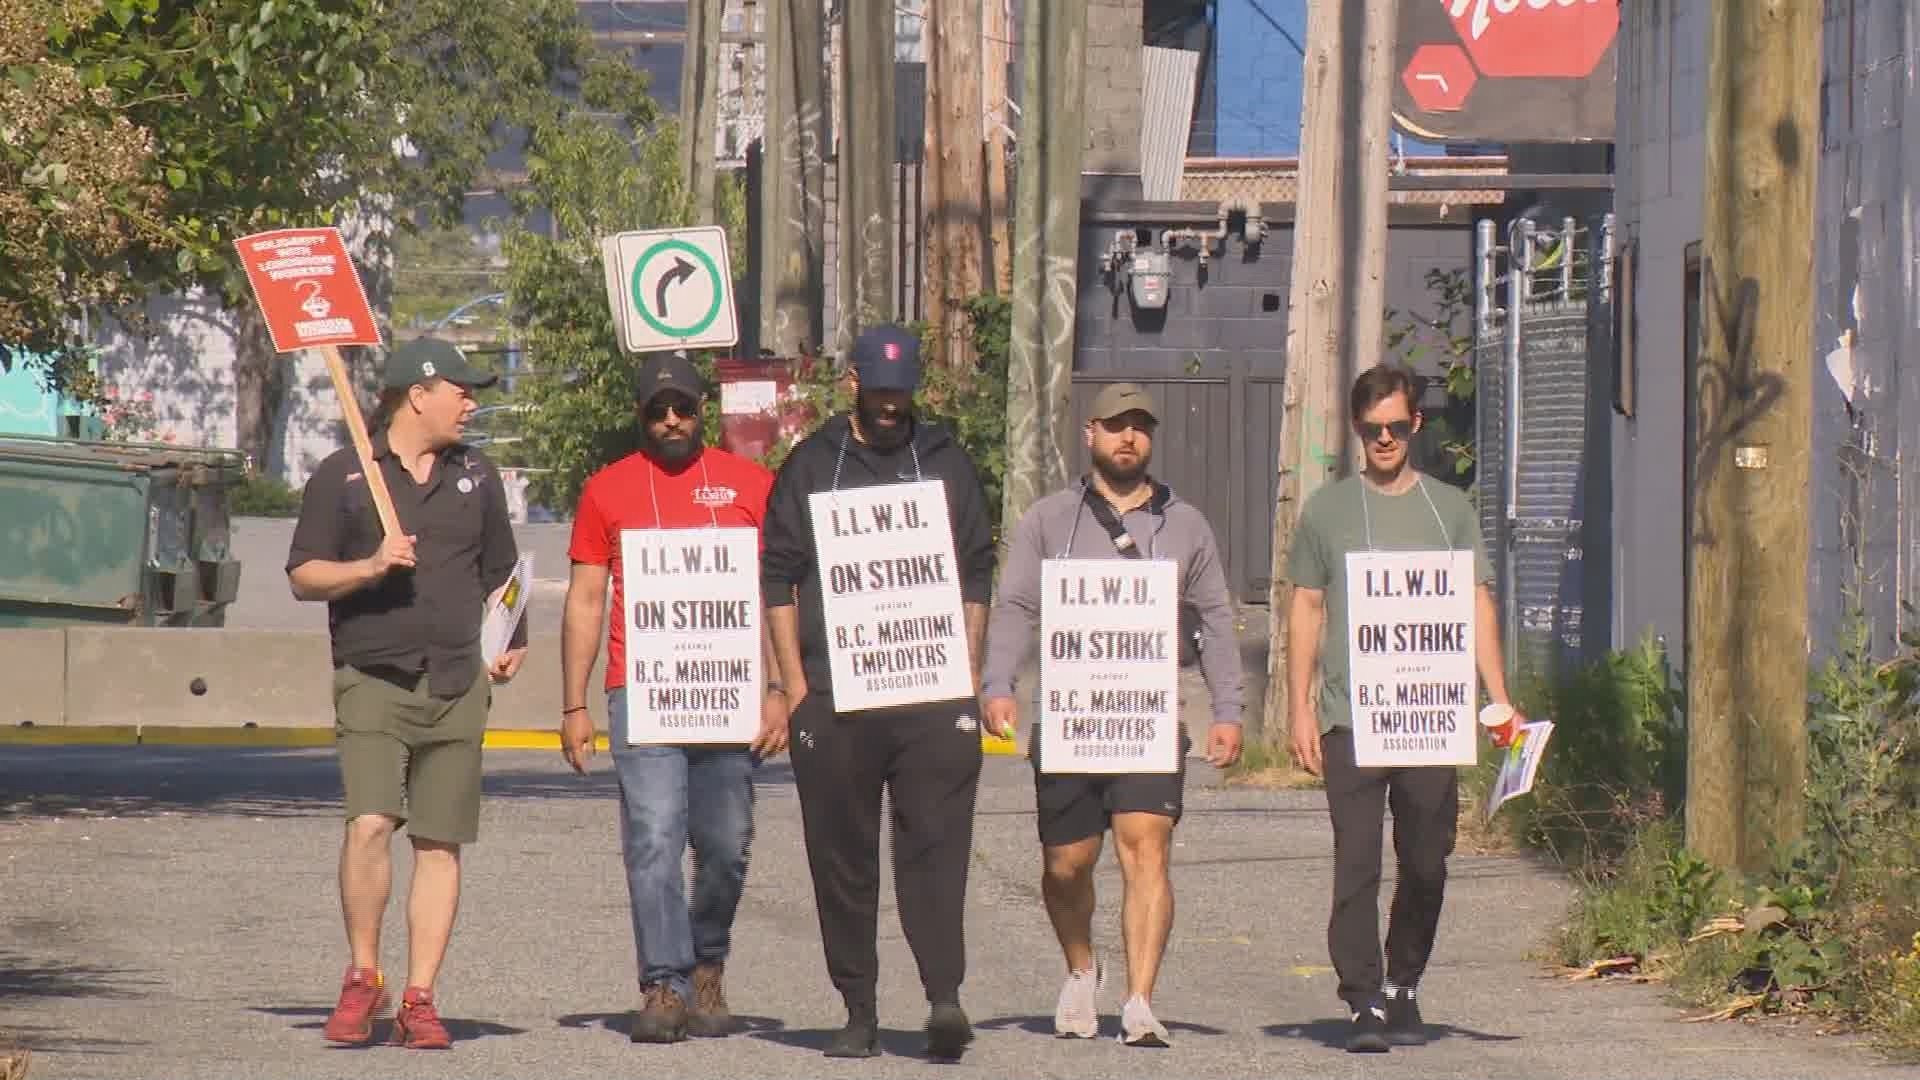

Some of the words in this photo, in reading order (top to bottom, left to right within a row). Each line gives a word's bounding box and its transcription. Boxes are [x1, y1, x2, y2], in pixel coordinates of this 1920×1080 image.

[832, 500, 928, 536] I.L.W.U.
[641, 547, 737, 575] I.L.W.U.
[830, 561, 863, 594] ON
[868, 553, 947, 590] STRIKE
[1060, 577, 1156, 605] I.L.W.U.
[1366, 569, 1455, 597] I.L.W.U.
[635, 600, 665, 629] ON
[672, 600, 751, 629] STRIKE
[835, 624, 873, 648] B.C.
[877, 614, 955, 645] MARITIME
[1358, 624, 1387, 653] ON
[1394, 622, 1468, 652] STRIKE
[1050, 631, 1082, 660] ON
[1089, 631, 1169, 660] STRIKE
[635, 660, 670, 683] B.C.
[675, 660, 752, 683] MARITIME
[852, 643, 947, 676] EMPLOYERS
[866, 671, 939, 692] ASSOCIATION
[1359, 684, 1391, 706] B.C.
[1396, 682, 1468, 706] MARITIME
[648, 687, 740, 711] EMPLOYERS
[1049, 690, 1085, 713] B.C.
[1091, 690, 1169, 713] MARITIME
[660, 715, 730, 728] ASSOCIATION
[1062, 717, 1156, 741] EMPLOYERS
[1372, 711, 1457, 734] EMPLOYERS
[1074, 744, 1146, 757] ASSOCIATION
[1383, 738, 1447, 751] ASSOCIATION
